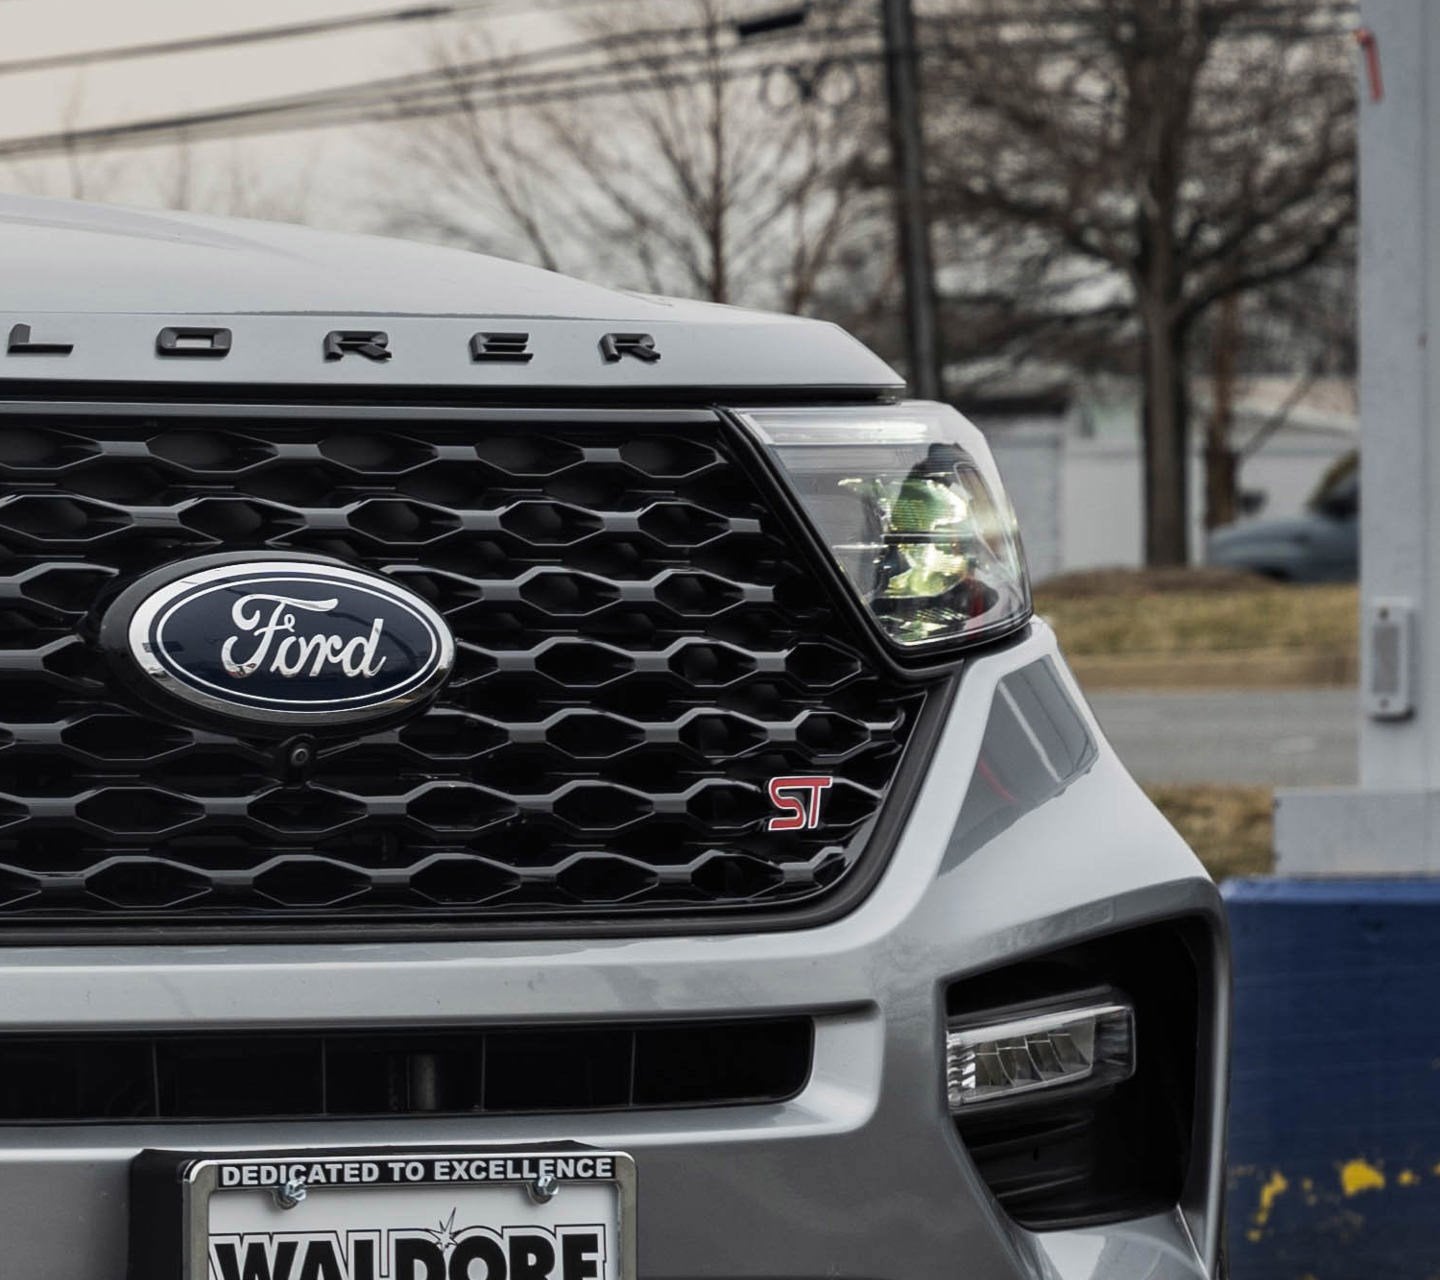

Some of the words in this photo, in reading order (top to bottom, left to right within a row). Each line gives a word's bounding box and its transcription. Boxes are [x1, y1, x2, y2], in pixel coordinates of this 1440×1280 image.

[221, 593, 387, 686] Ford
[766, 775, 834, 833] ST
[221, 1161, 380, 1188] DEDICATED
[388, 1160, 426, 1183] TO
[434, 1157, 613, 1182] EXCELLENCE
